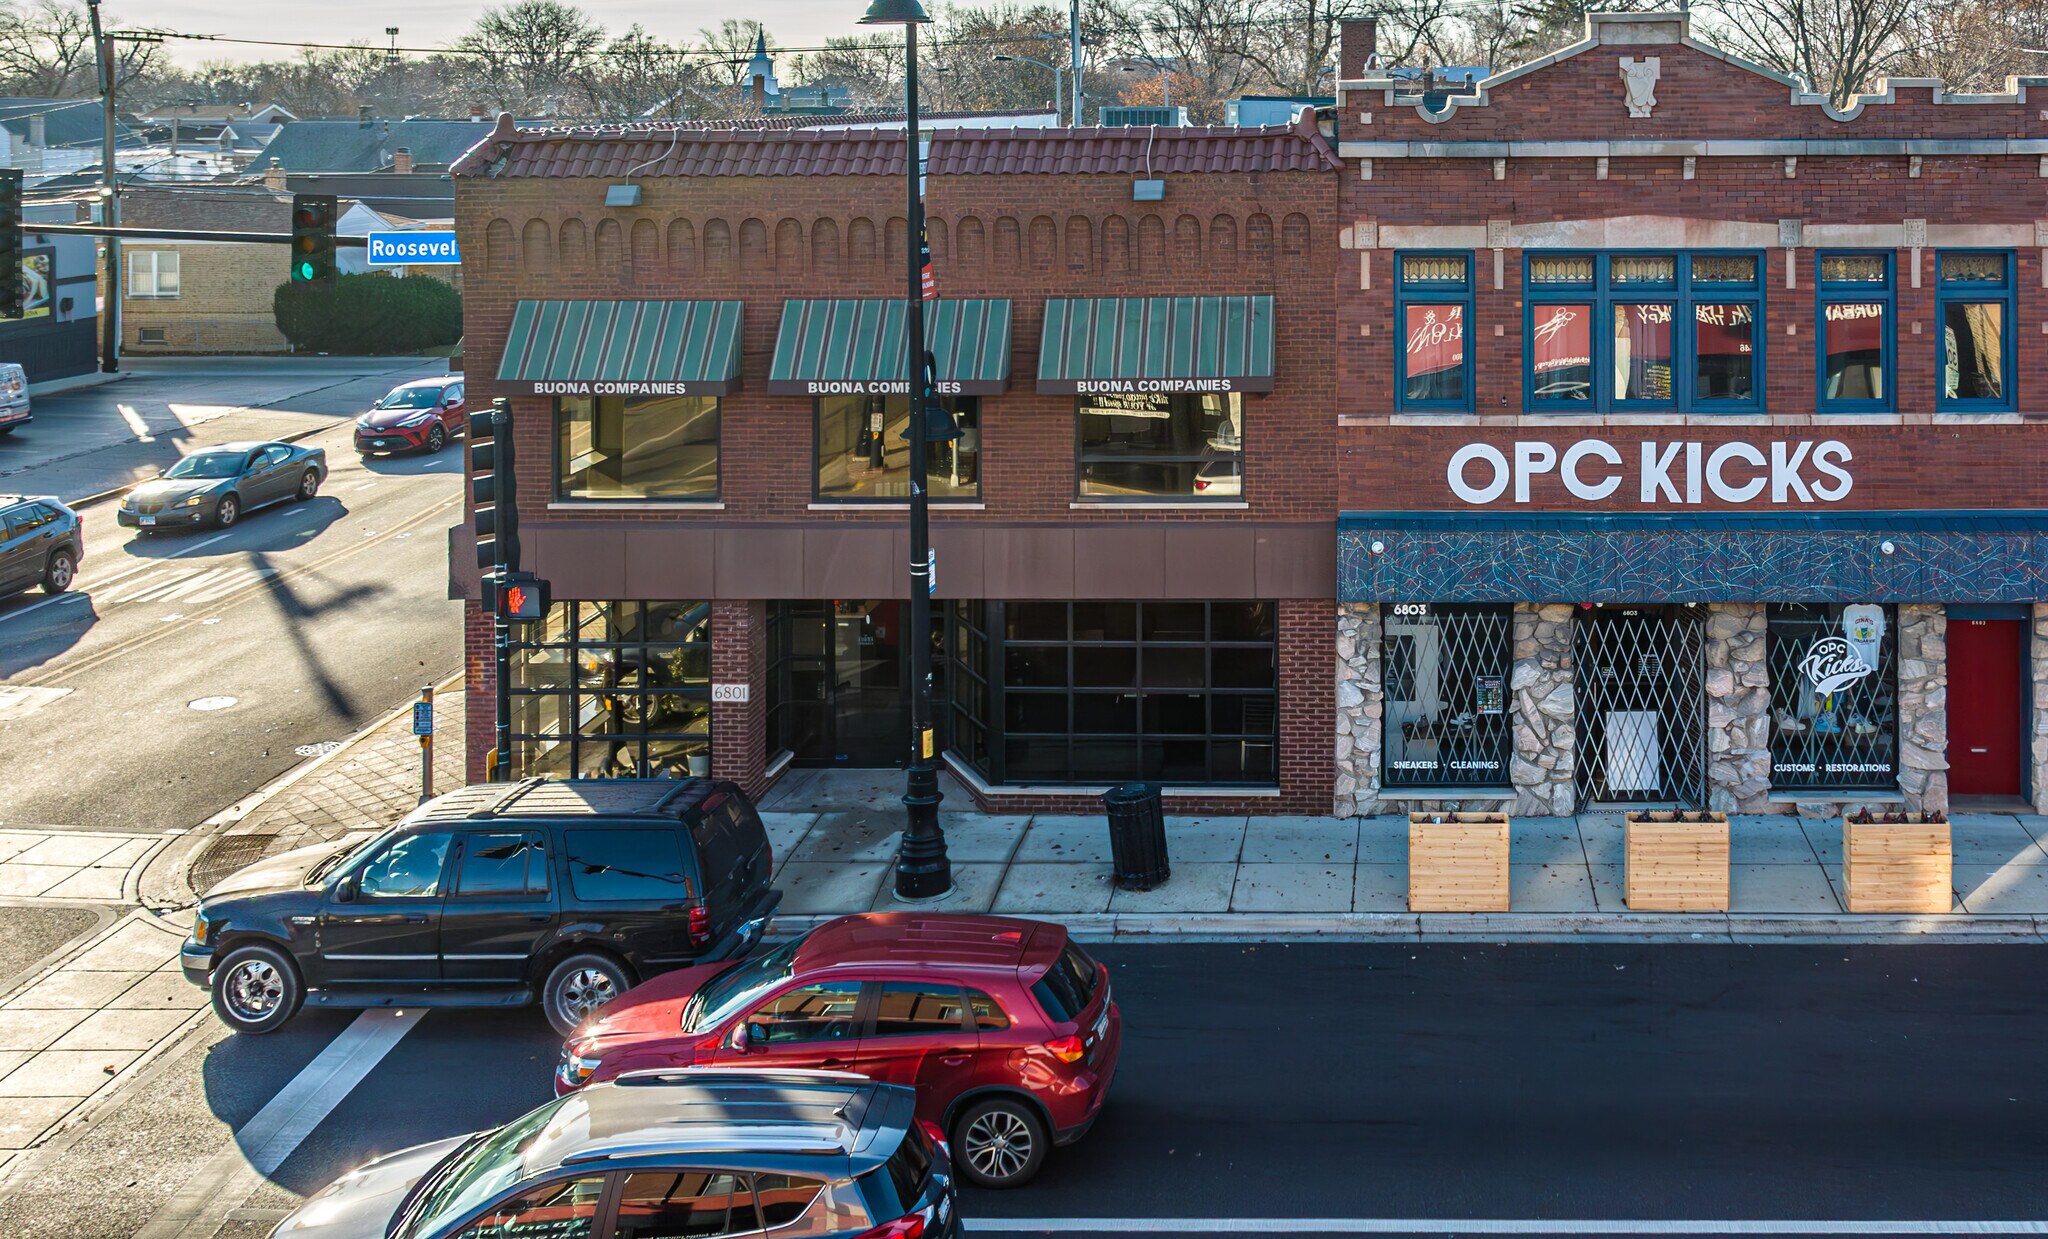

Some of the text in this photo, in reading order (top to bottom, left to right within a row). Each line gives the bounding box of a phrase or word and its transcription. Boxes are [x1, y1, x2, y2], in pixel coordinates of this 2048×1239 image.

[372, 239, 456, 257] Roosevel
[533, 382, 686, 394] BUONA COMPANIES
[807, 381, 962, 394] BUONA COMPIES
[1076, 379, 1232, 393] BUONA COMPANIES
[1447, 438, 1854, 504] OPC KICKS
[1393, 604, 1427, 616] 6803
[1819, 642, 1846, 655] OPC
[1797, 653, 1863, 681] Kicks
[714, 686, 746, 699] 6801
[1393, 761, 1500, 770] SNEAKERS CLEANINGS
[1773, 763, 1891, 772] CUSTOMS RESTORATIONS
